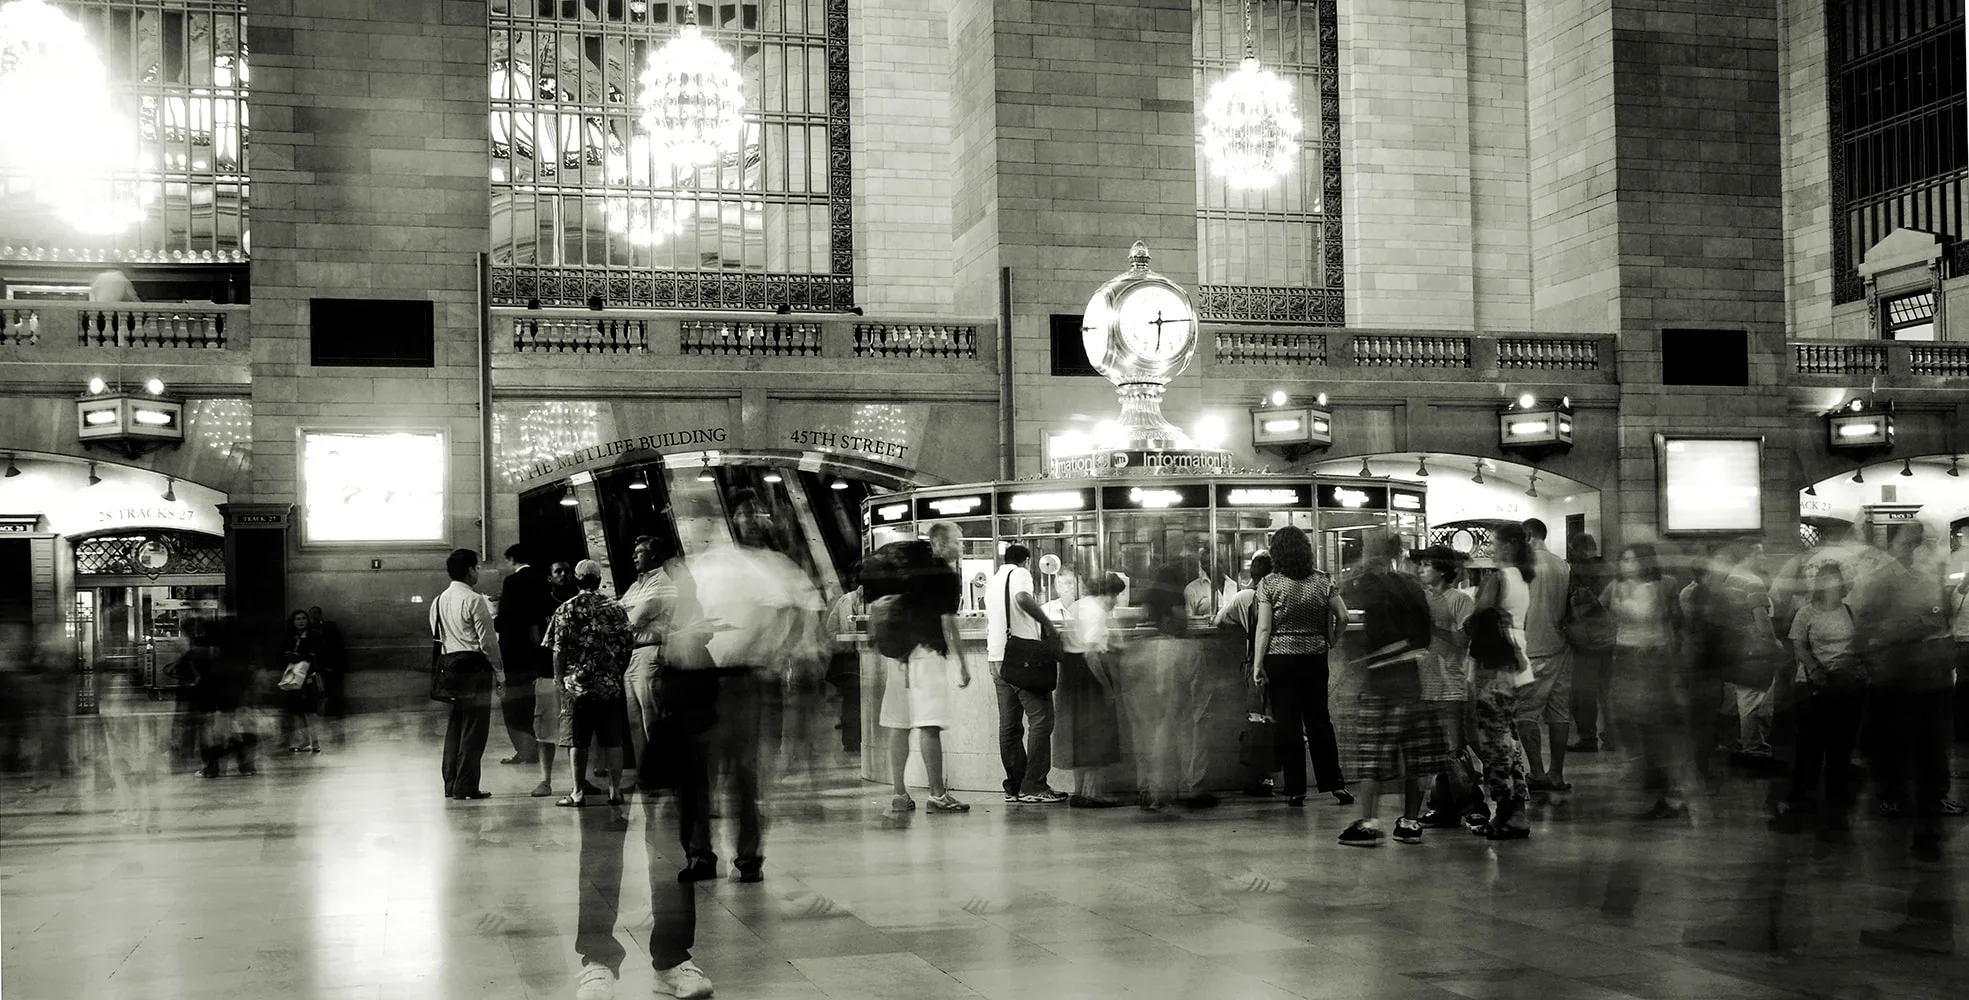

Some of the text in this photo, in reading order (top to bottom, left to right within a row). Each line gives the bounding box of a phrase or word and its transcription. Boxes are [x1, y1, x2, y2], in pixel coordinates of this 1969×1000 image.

[513, 428, 727, 482] THE METLIFE BUILDING
[790, 429, 908, 459] 45TH STREET
[1143, 451, 1221, 467] Information
[119, 507, 175, 520] TRACKS
[179, 510, 195, 521] 27
